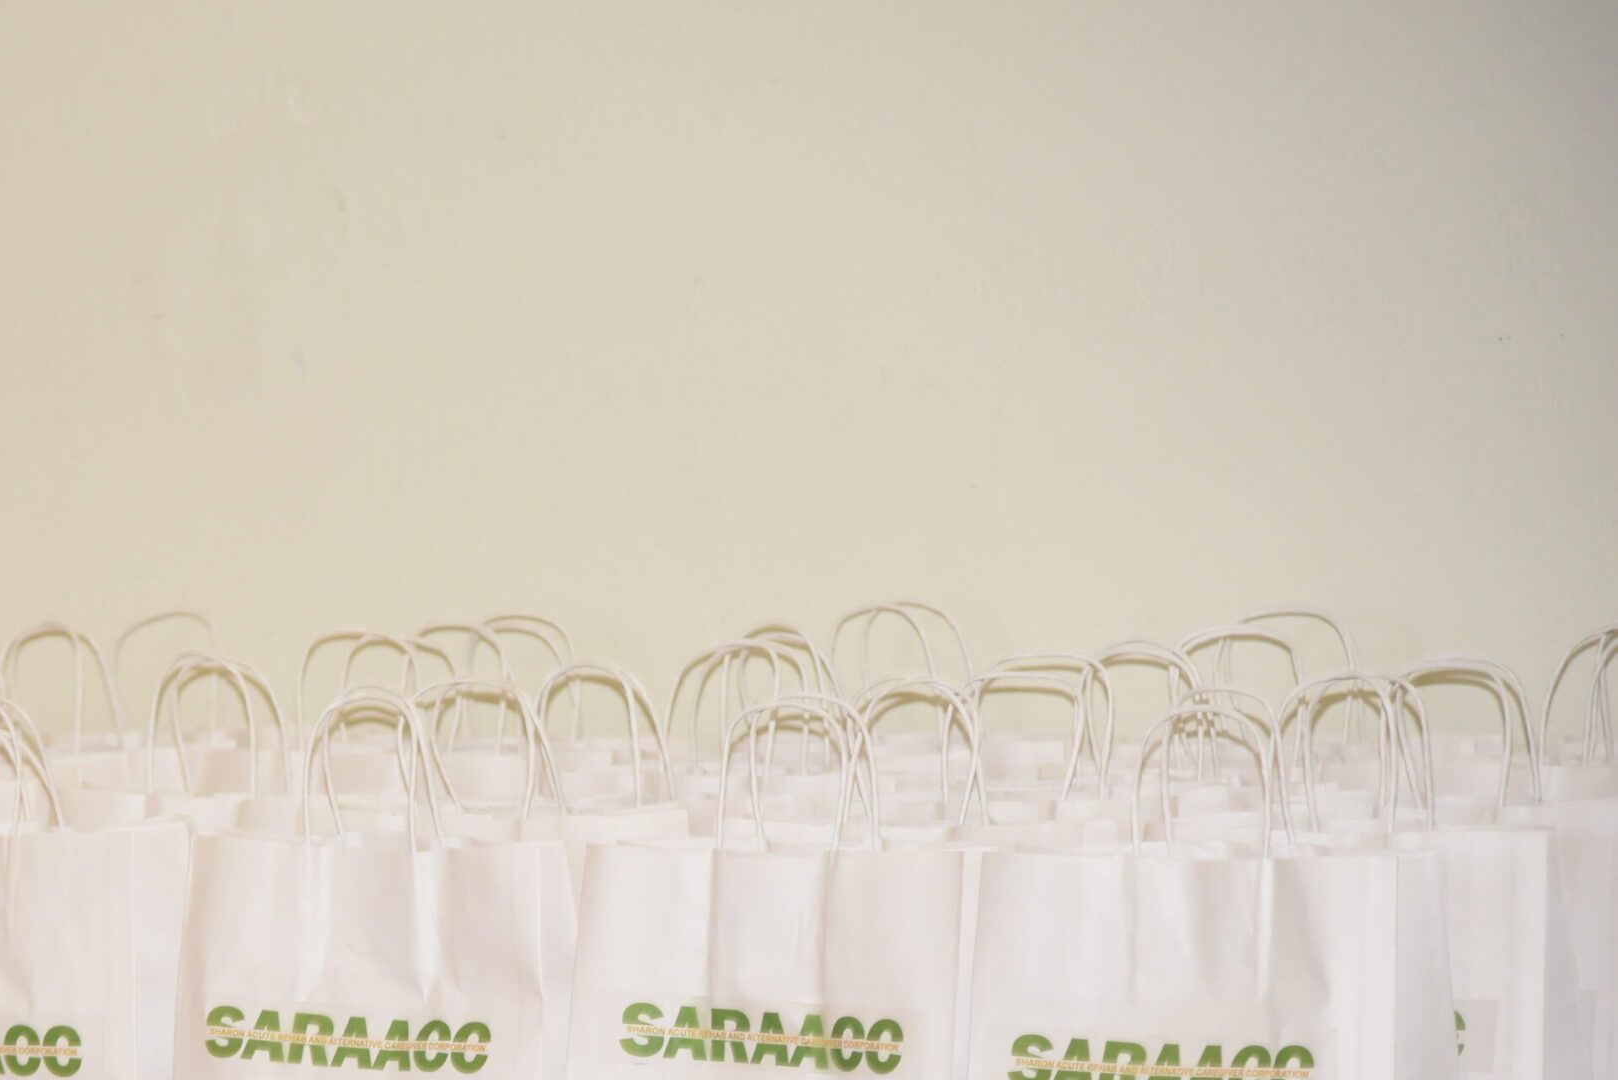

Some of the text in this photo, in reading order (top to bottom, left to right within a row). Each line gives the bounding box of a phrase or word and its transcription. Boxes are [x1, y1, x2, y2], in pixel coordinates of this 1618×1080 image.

[204, 1005, 491, 1074] SARAACC
[208, 1027, 245, 1038] SHARON
[247, 1029, 275, 1040] ACUTE
[309, 1034, 327, 1045] AND
[329, 1036, 383, 1048] ALTERNATIVE
[428, 1042, 486, 1053] CORPORATION
[618, 1002, 904, 1075] SARAACC
[627, 1025, 664, 1036] SHARON
[667, 1027, 697, 1038] ACUTE
[728, 1031, 745, 1042] AND
[747, 1032, 798, 1045] ALTERNATIVE
[843, 1039, 899, 1051] CORPORATION
[1016, 1057, 1054, 1068] SHARON
[1119, 1064, 1137, 1074] AND
[1245, 1068, 1309, 1079] CORPORATION
